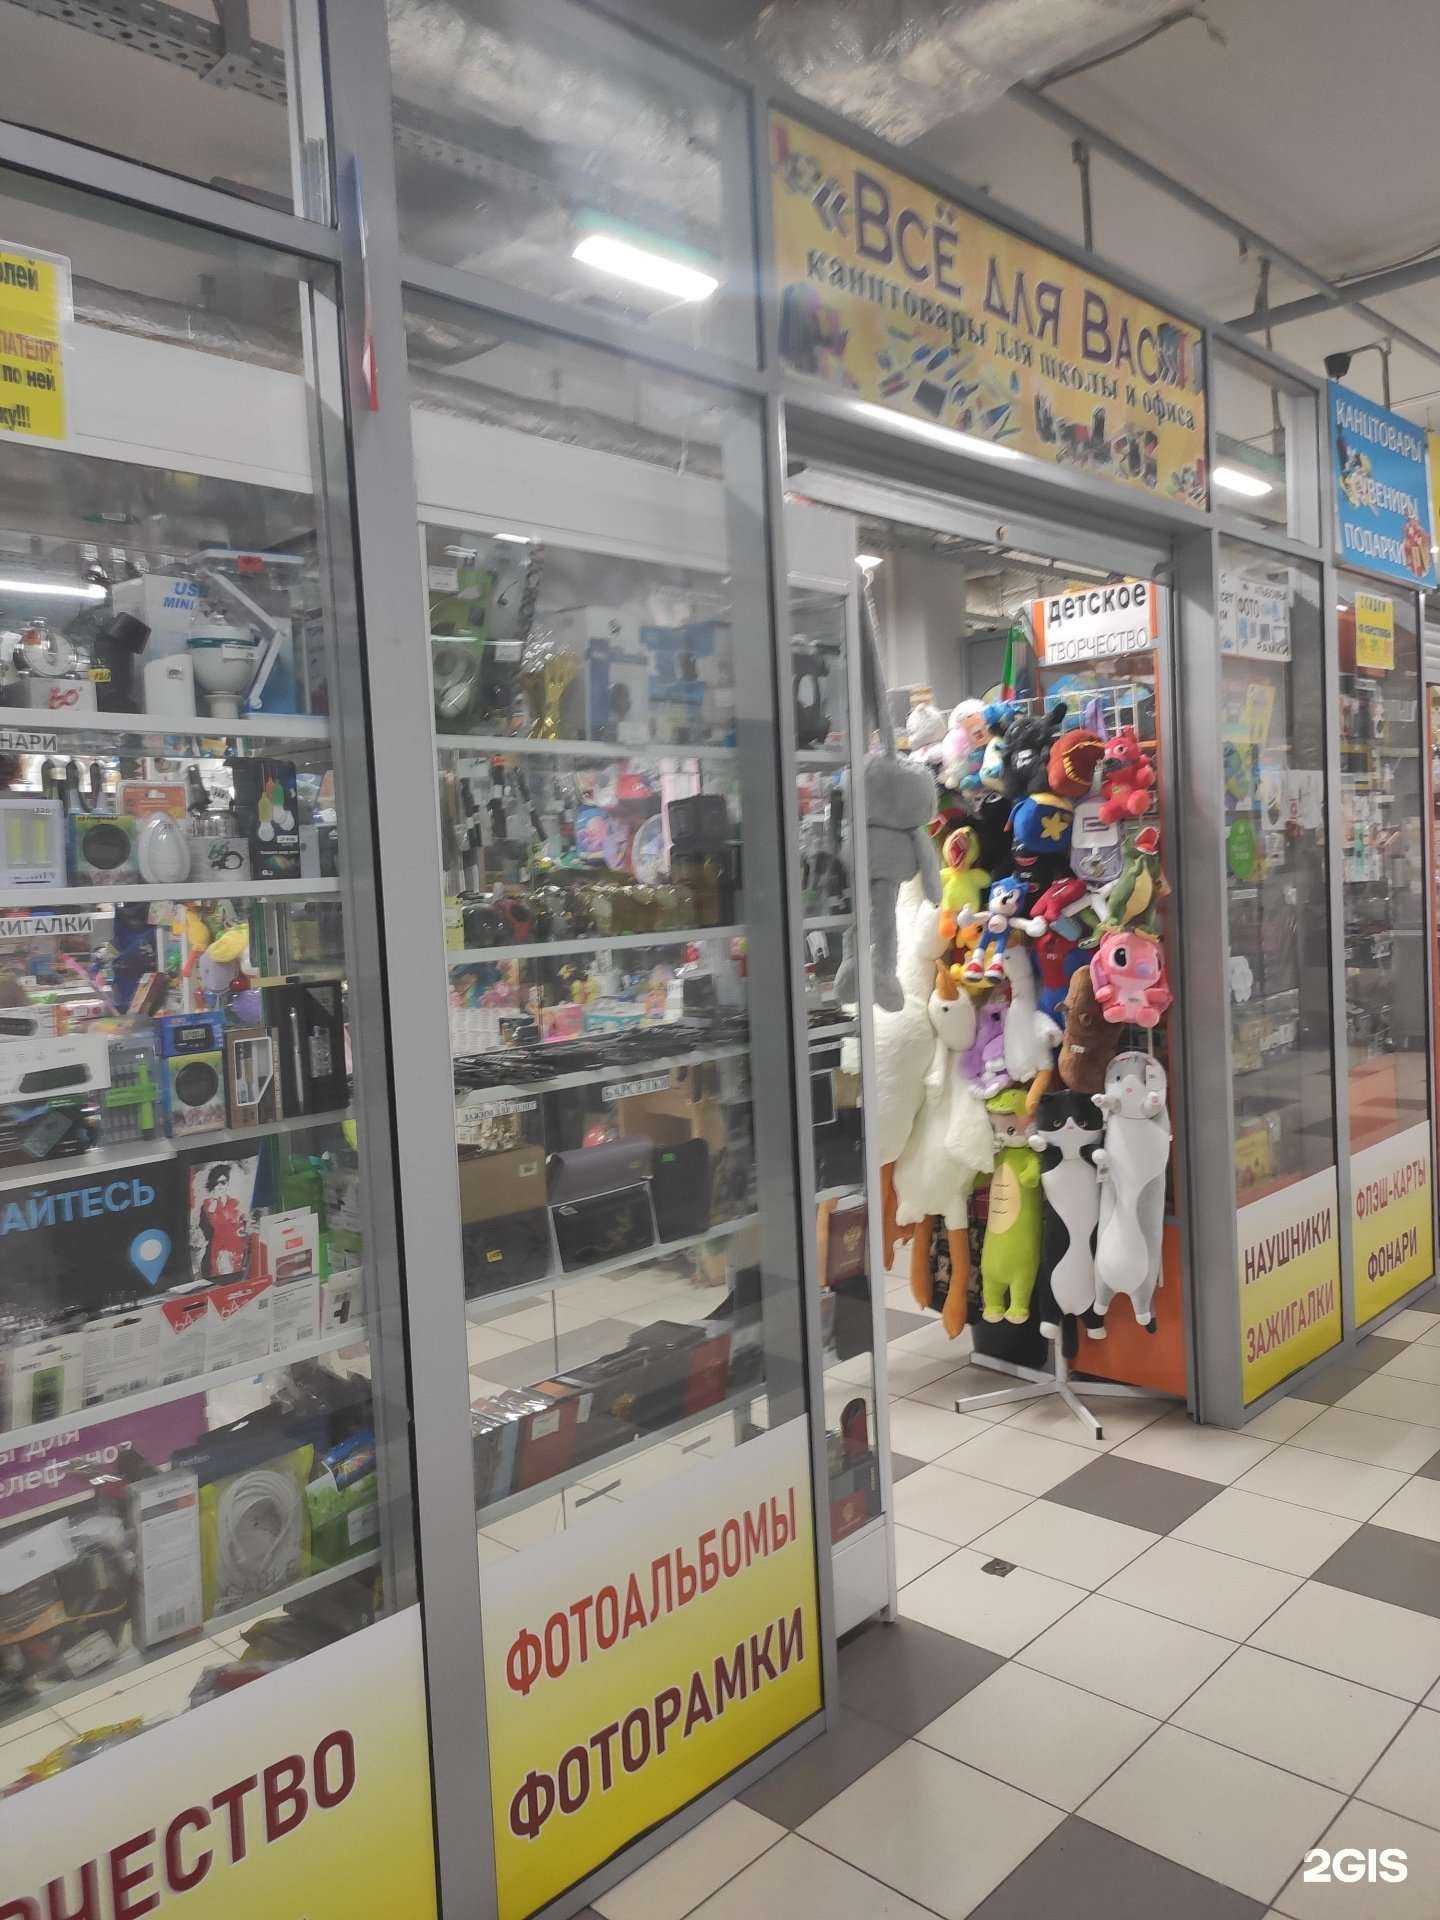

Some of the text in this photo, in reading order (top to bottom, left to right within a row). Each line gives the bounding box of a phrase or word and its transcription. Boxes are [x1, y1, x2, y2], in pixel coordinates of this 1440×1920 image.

[3, 364, 22, 385] по
[994, 329, 1033, 368] для
[1039, 352, 1118, 400] школы
[1125, 384, 1137, 407] и
[1142, 391, 1196, 432] офиса
[1336, 398, 1424, 465] КАНЦТОВАРЫ
[1343, 521, 1408, 566] ПОДАРКИ
[1047, 626, 1148, 662] ТВОРЧЕСТВО
[0, 1177, 156, 1236] АЙТЕСЬ
[1356, 1157, 1426, 1220] ФЛЭШ-КАРТЫ
[1244, 1207, 1332, 1285] НАУШНИКИ
[1367, 1225, 1418, 1283] ФОНАРИ
[1246, 1279, 1335, 1364] ЗАЖИГАЛКИ
[505, 1486, 798, 1697] ФОТОАЛЬБОМЫ
[509, 1606, 805, 1841] ФОТОРАМКИ
